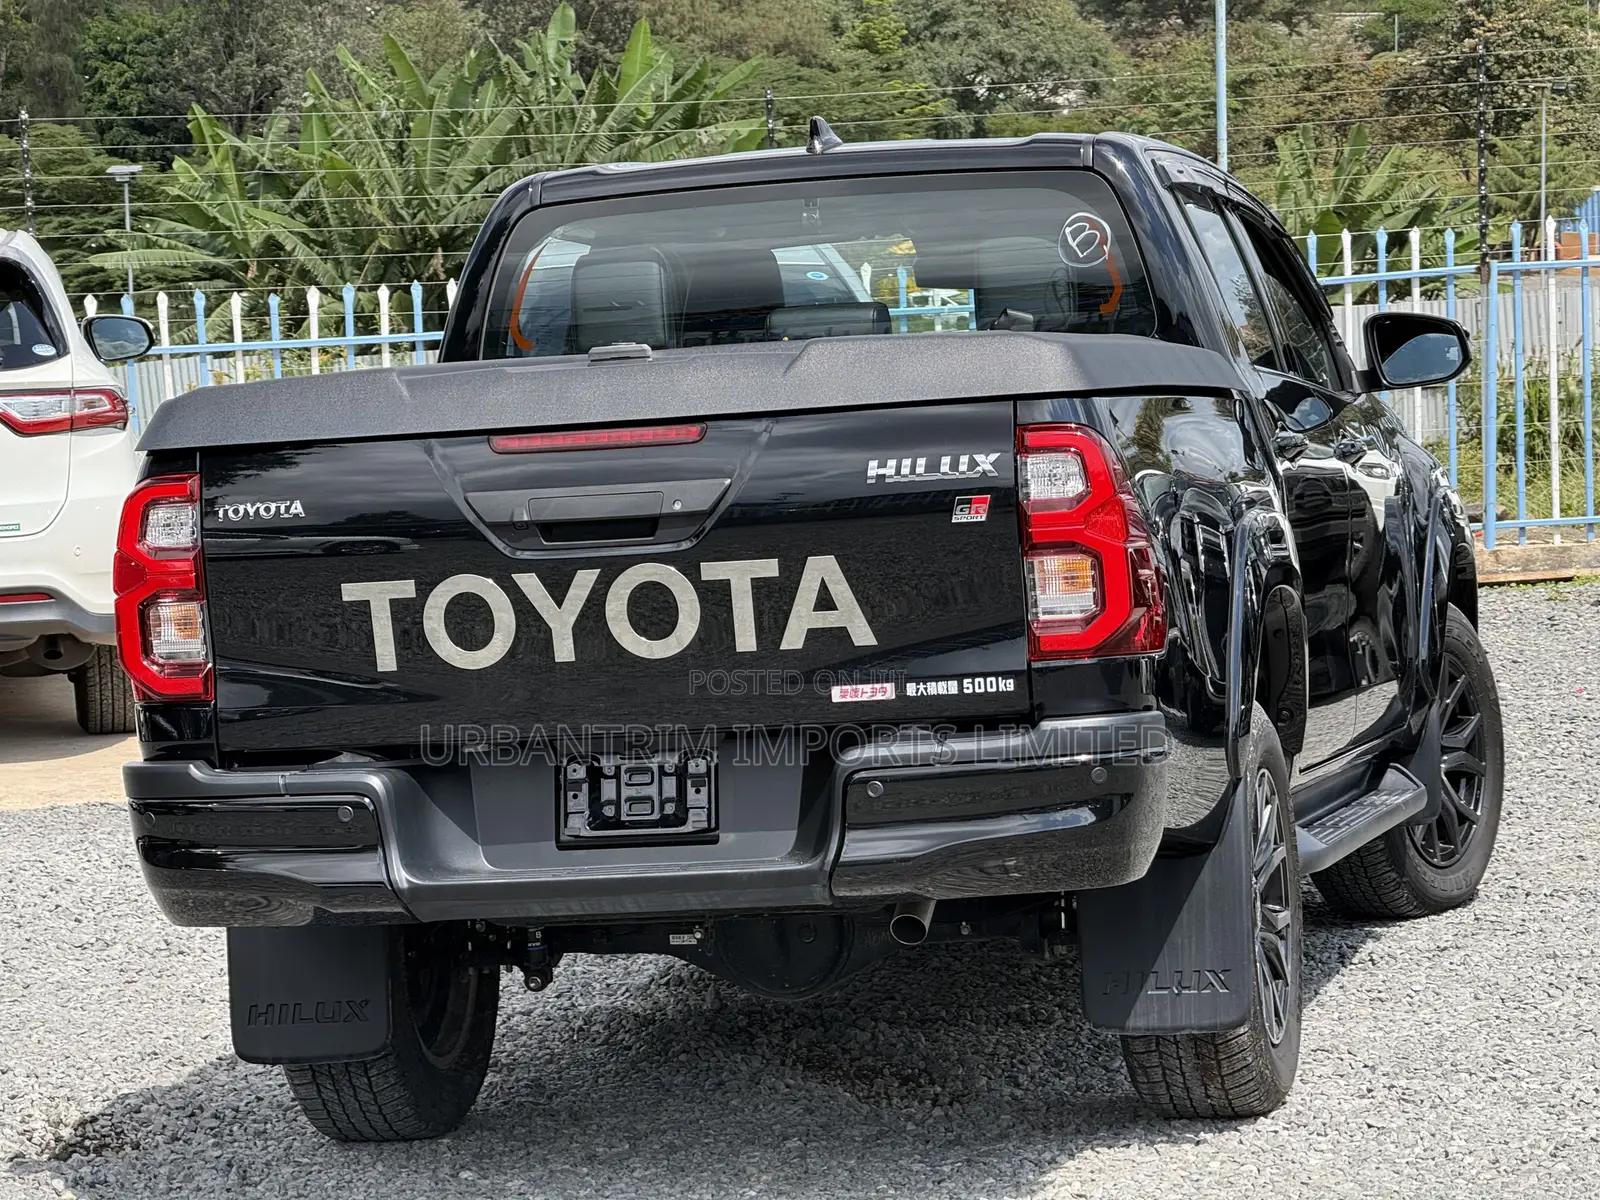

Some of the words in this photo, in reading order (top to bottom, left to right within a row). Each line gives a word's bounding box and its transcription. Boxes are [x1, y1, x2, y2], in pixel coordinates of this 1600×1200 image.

[866, 452, 1001, 483] HILUX
[214, 499, 306, 522] TOYOTA
[955, 503, 987, 515] GR
[340, 555, 878, 672] TOYOTA
[906, 680, 959, 697] 最大積載量
[962, 676, 1015, 694] 500kg
[247, 998, 371, 1027] HILUX
